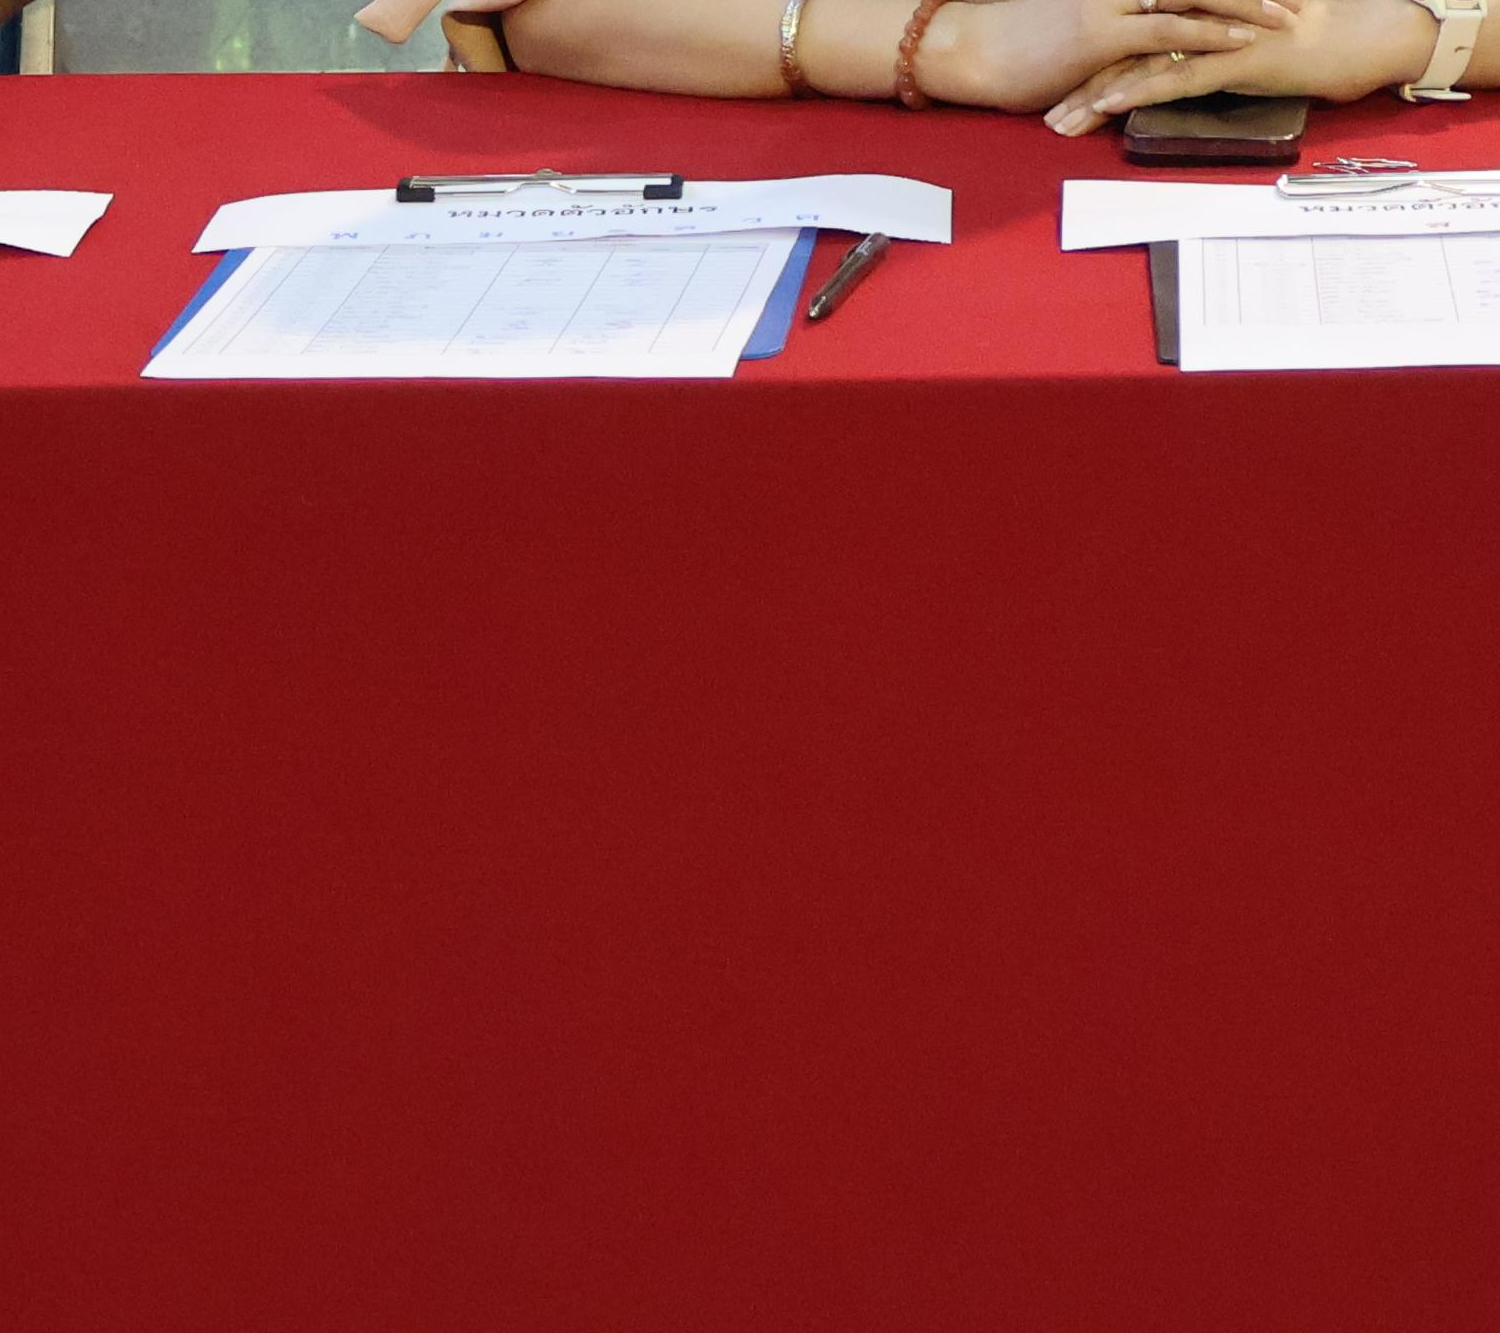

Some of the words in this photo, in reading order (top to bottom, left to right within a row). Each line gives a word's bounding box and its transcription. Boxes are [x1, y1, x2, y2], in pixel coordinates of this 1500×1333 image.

[448, 202, 718, 219] หมวดตัวอักษร
